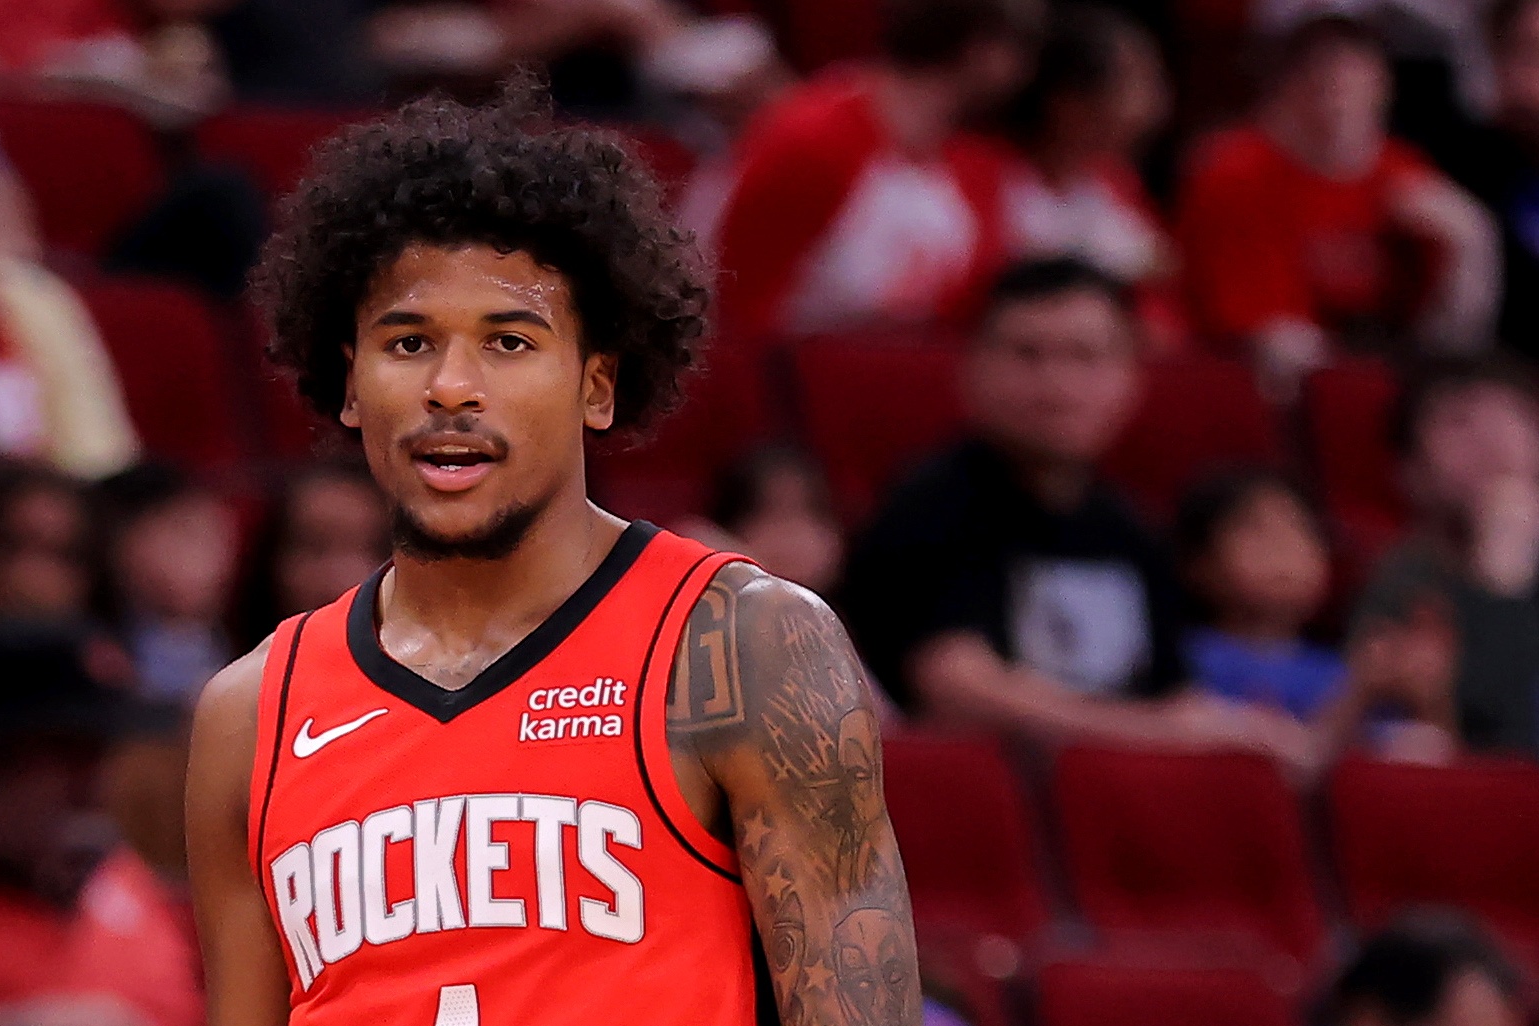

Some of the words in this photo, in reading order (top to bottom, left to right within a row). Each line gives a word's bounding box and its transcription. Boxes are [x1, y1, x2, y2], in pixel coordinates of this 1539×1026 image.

[529, 678, 627, 710] credit
[519, 712, 622, 741] karma
[271, 793, 644, 993] ROCKETS
